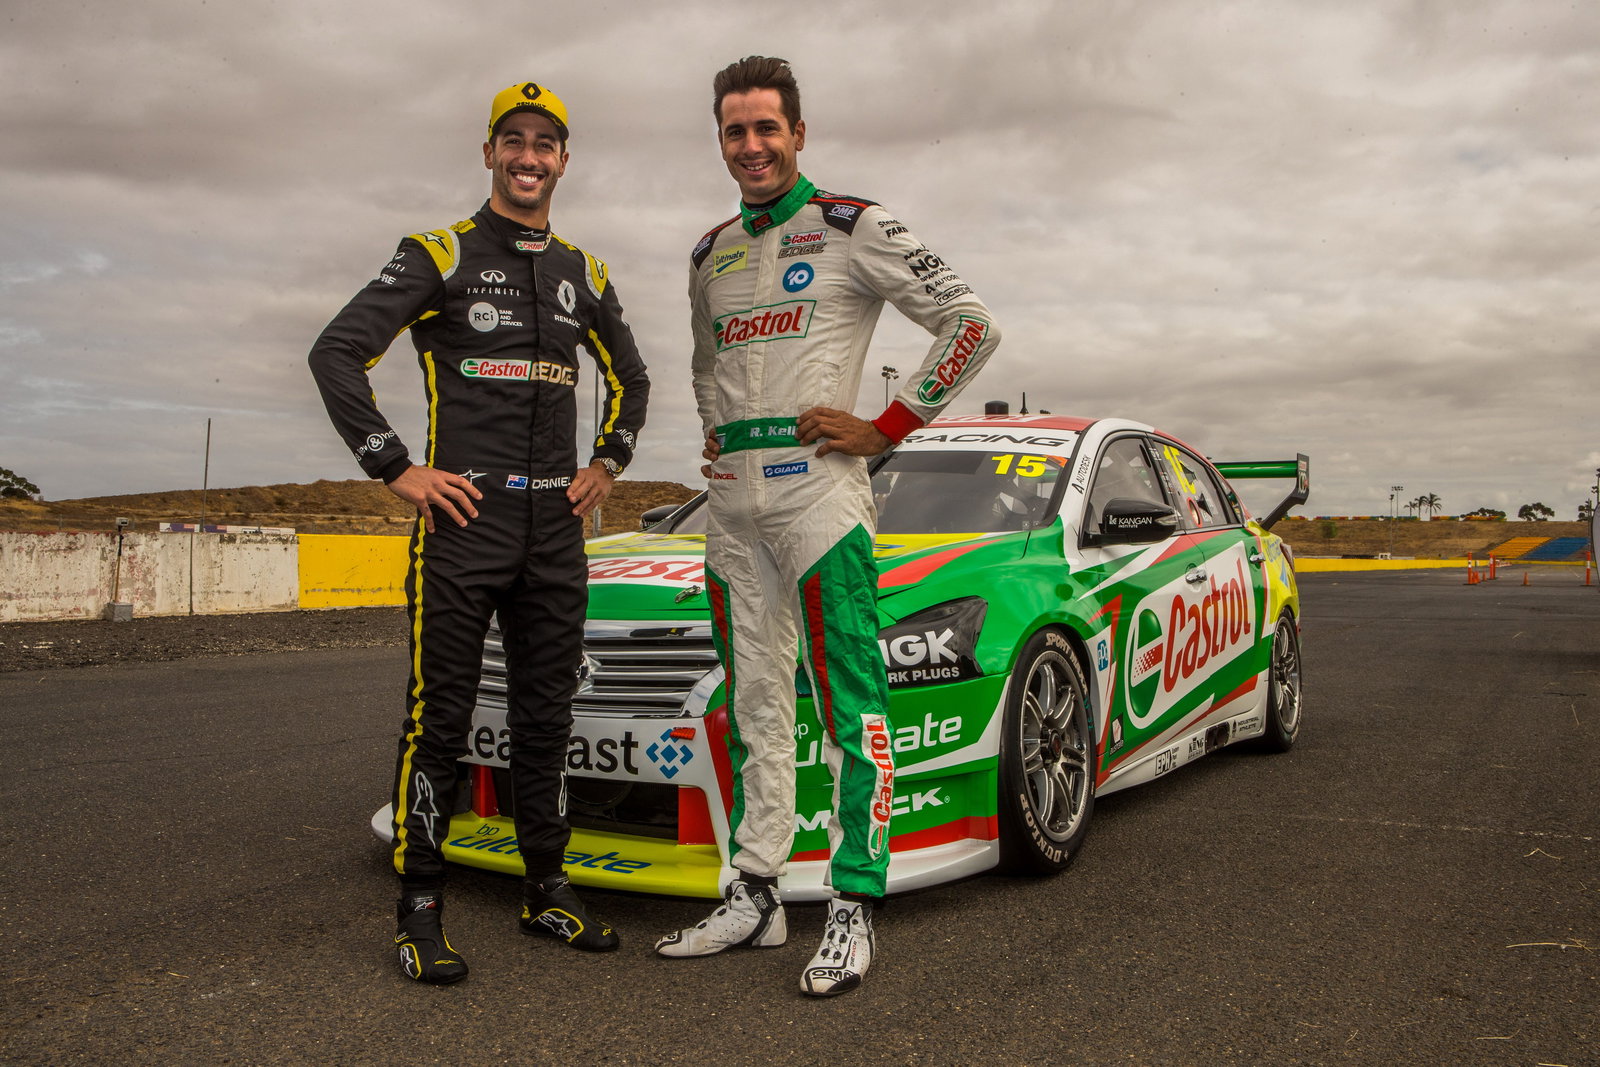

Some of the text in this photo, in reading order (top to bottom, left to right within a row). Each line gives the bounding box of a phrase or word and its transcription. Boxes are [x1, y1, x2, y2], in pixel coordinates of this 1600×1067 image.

[831, 206, 856, 217] OMP
[791, 232, 823, 244] Castrol
[715, 250, 745, 266] ultimate
[778, 243, 827, 258] EDGE
[787, 269, 809, 286] 10
[467, 287, 520, 297] INFINITI
[724, 304, 803, 345] Castrol
[937, 319, 986, 389] Castrol
[480, 361, 528, 377] Castrol
[750, 425, 799, 438] R. Kell
[774, 464, 806, 475] GIANT
[992, 454, 1047, 477] 15
[1076, 454, 1091, 484] AUTODESK
[1118, 517, 1153, 525] KANGAN
[1163, 557, 1251, 693] Castrol
[912, 666, 960, 681] PLUGS
[866, 721, 895, 823] Castrol
[476, 824, 500, 837] bp
[1020, 793, 1062, 863] DUNLOP
